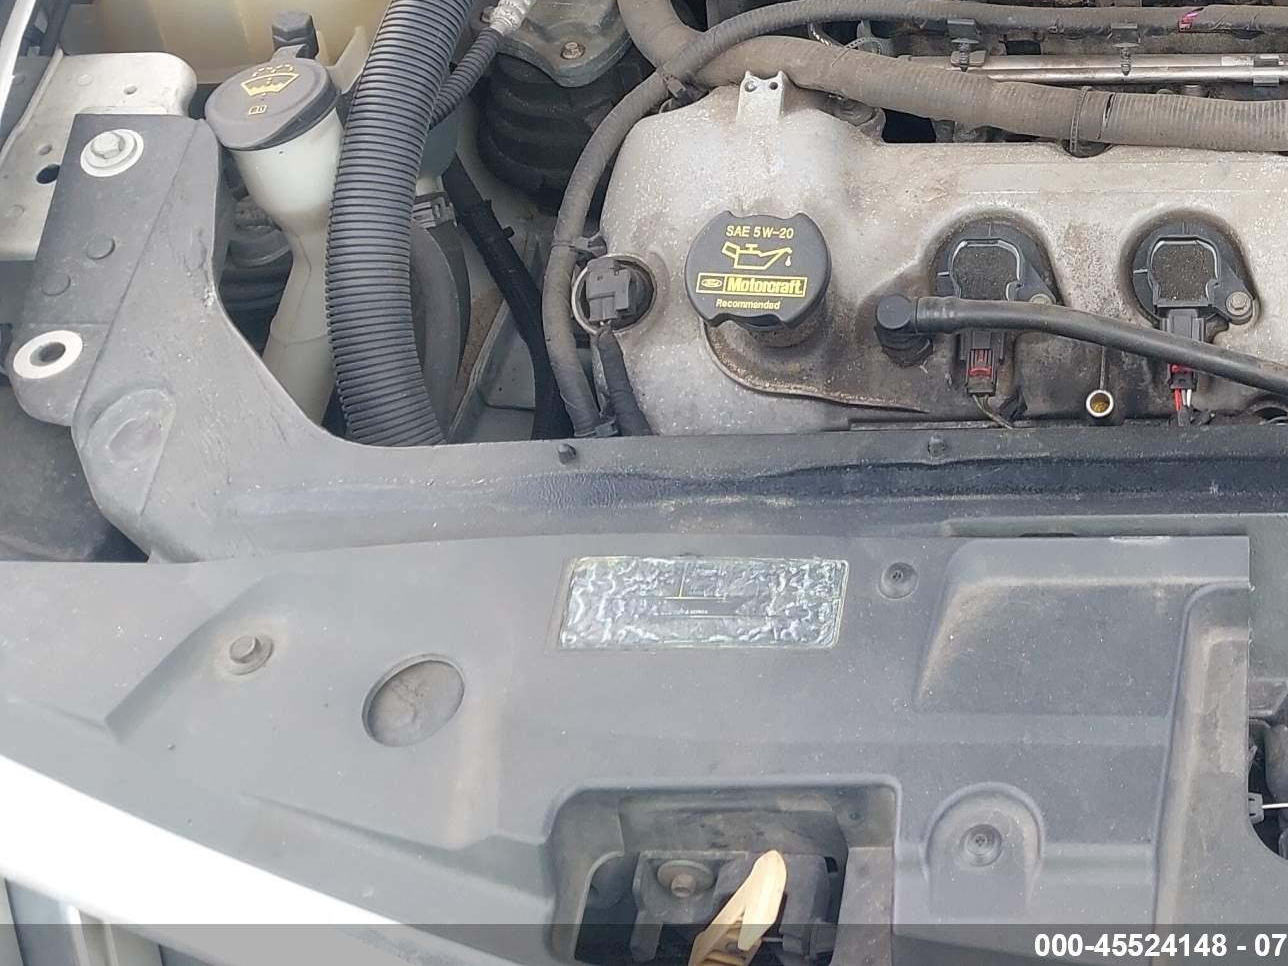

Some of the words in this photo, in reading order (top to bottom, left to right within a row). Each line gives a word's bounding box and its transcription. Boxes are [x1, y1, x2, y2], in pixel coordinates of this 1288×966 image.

[726, 226, 750, 237] SAE
[753, 227, 794, 239] 5W-20
[716, 298, 781, 310] Recommended
